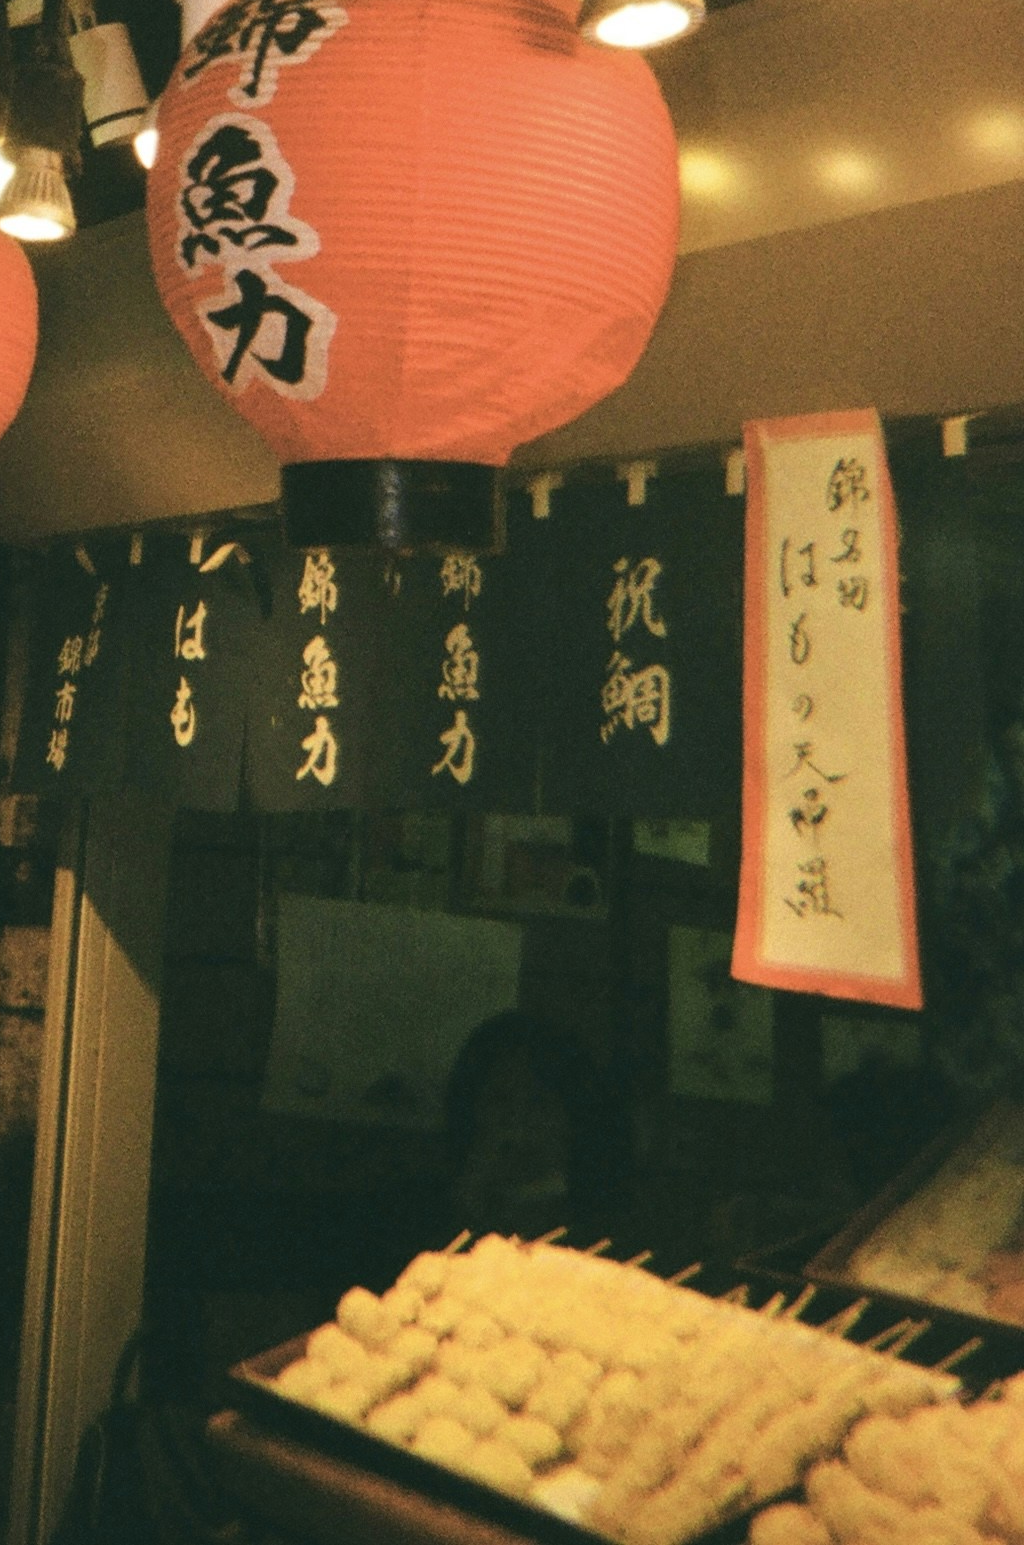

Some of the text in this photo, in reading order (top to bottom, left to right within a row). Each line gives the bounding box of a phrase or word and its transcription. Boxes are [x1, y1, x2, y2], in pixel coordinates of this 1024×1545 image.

[45, 634, 84, 773] 錦市場
[169, 599, 208, 748] はも
[295, 551, 340, 787] 錦魚力
[600, 555, 672, 747] 祝鯛
